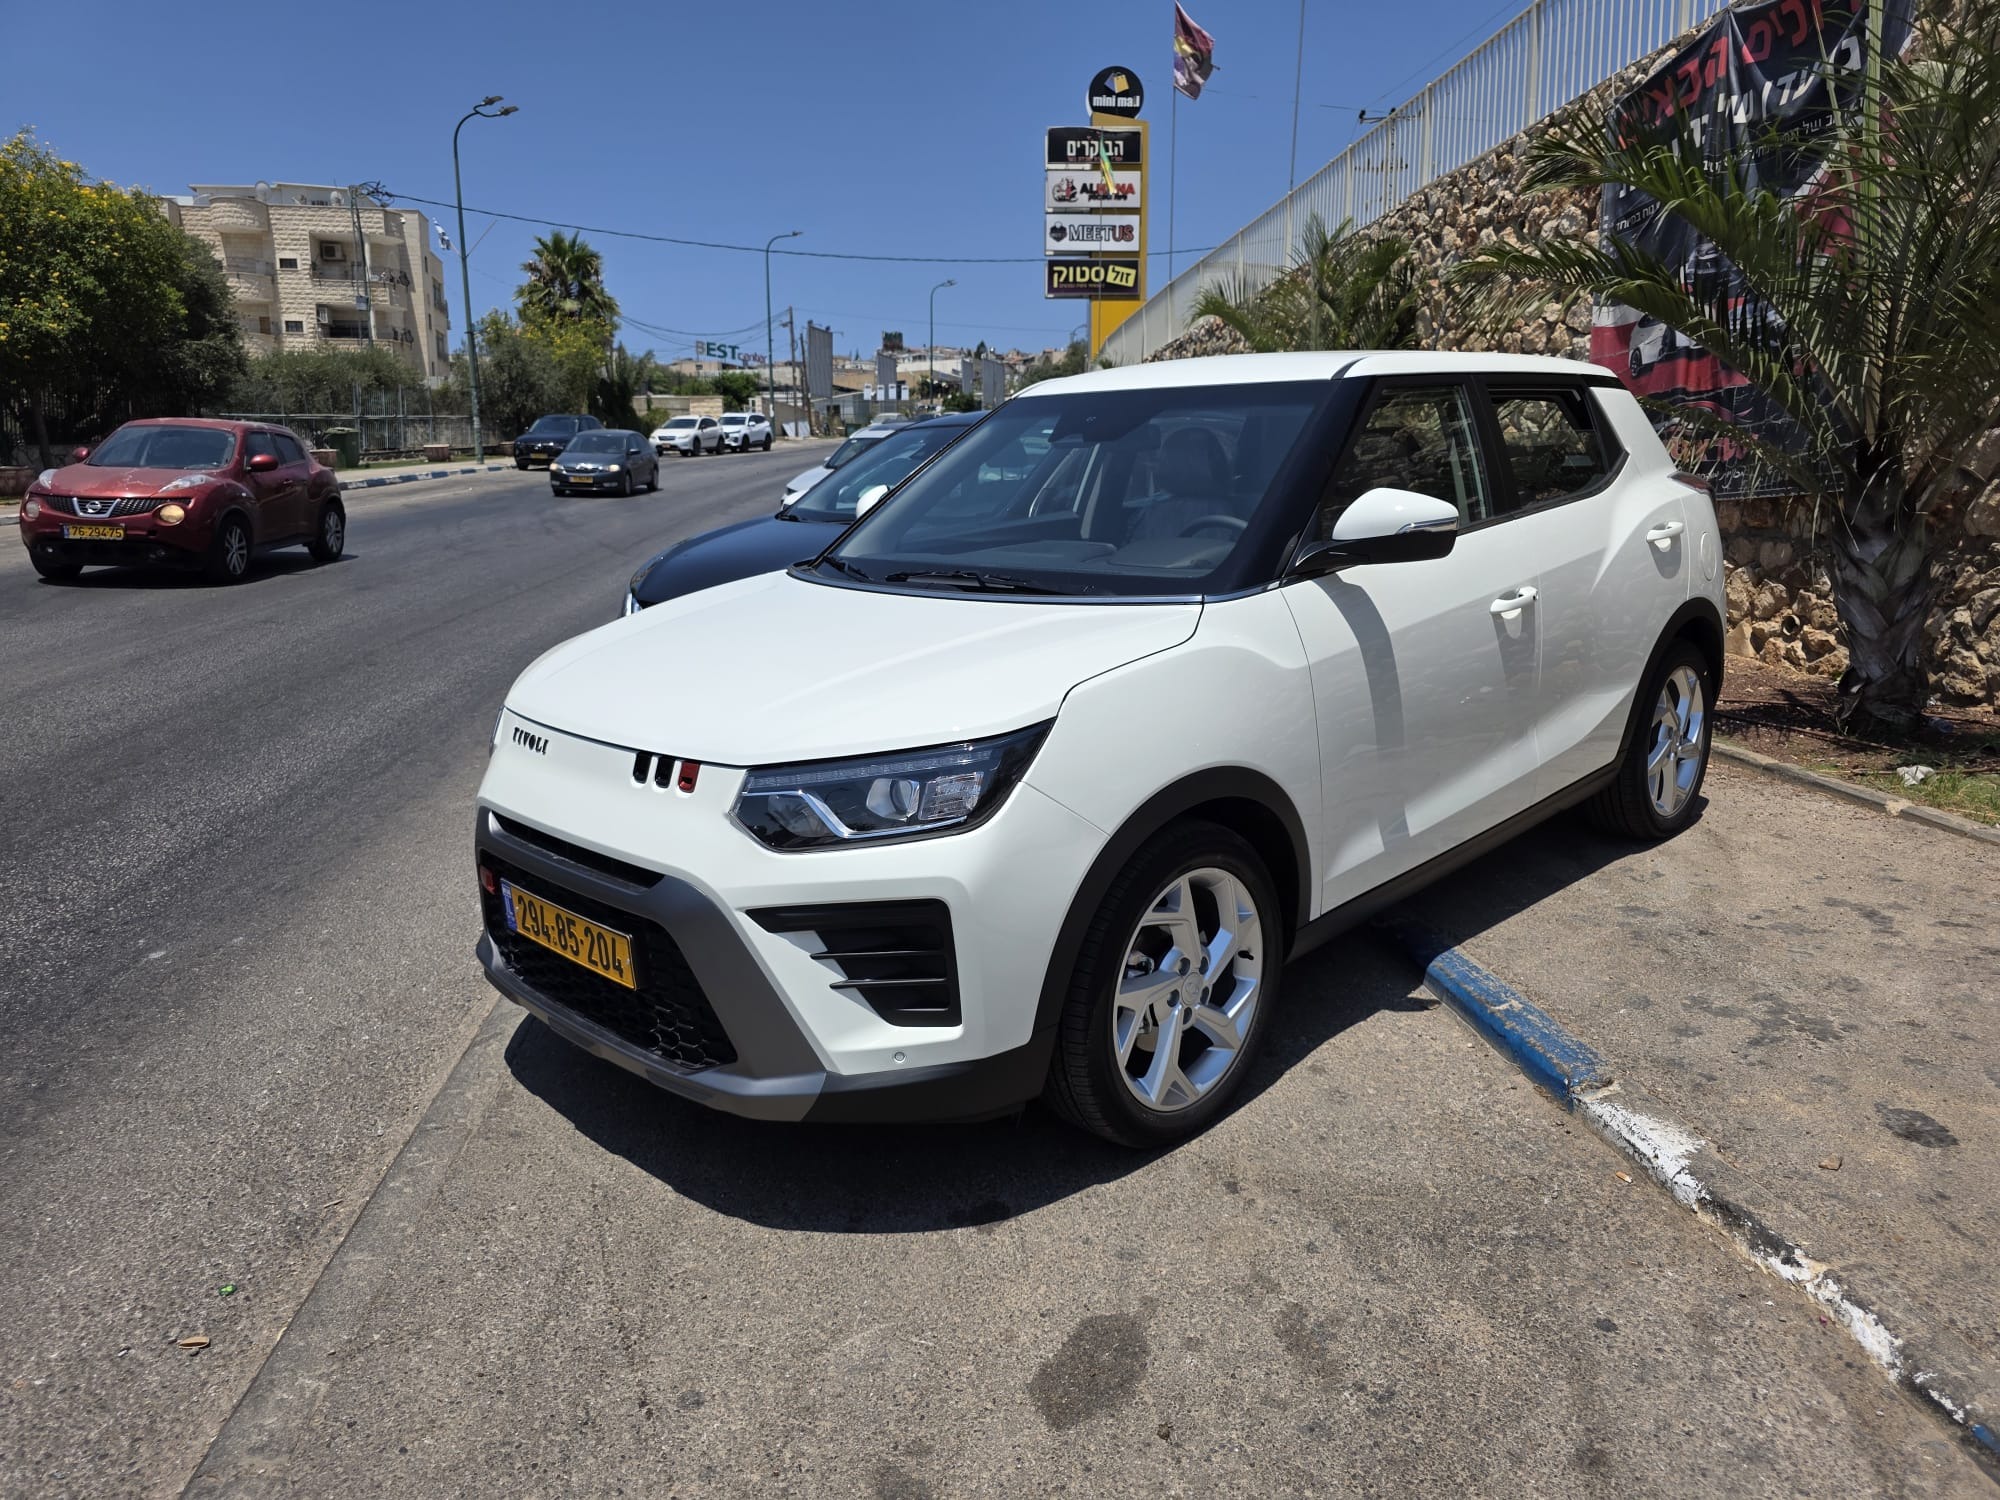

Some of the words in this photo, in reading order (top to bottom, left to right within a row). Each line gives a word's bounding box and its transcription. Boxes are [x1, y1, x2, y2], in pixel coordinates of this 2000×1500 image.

[1092, 94, 1116, 107] mini
[1066, 140, 1124, 159] הבקרים
[1052, 265, 1106, 289] סטוק
[1111, 266, 1132, 284] זול
[695, 340, 740, 360] BEST
[512, 726, 549, 755] TIVOLI
